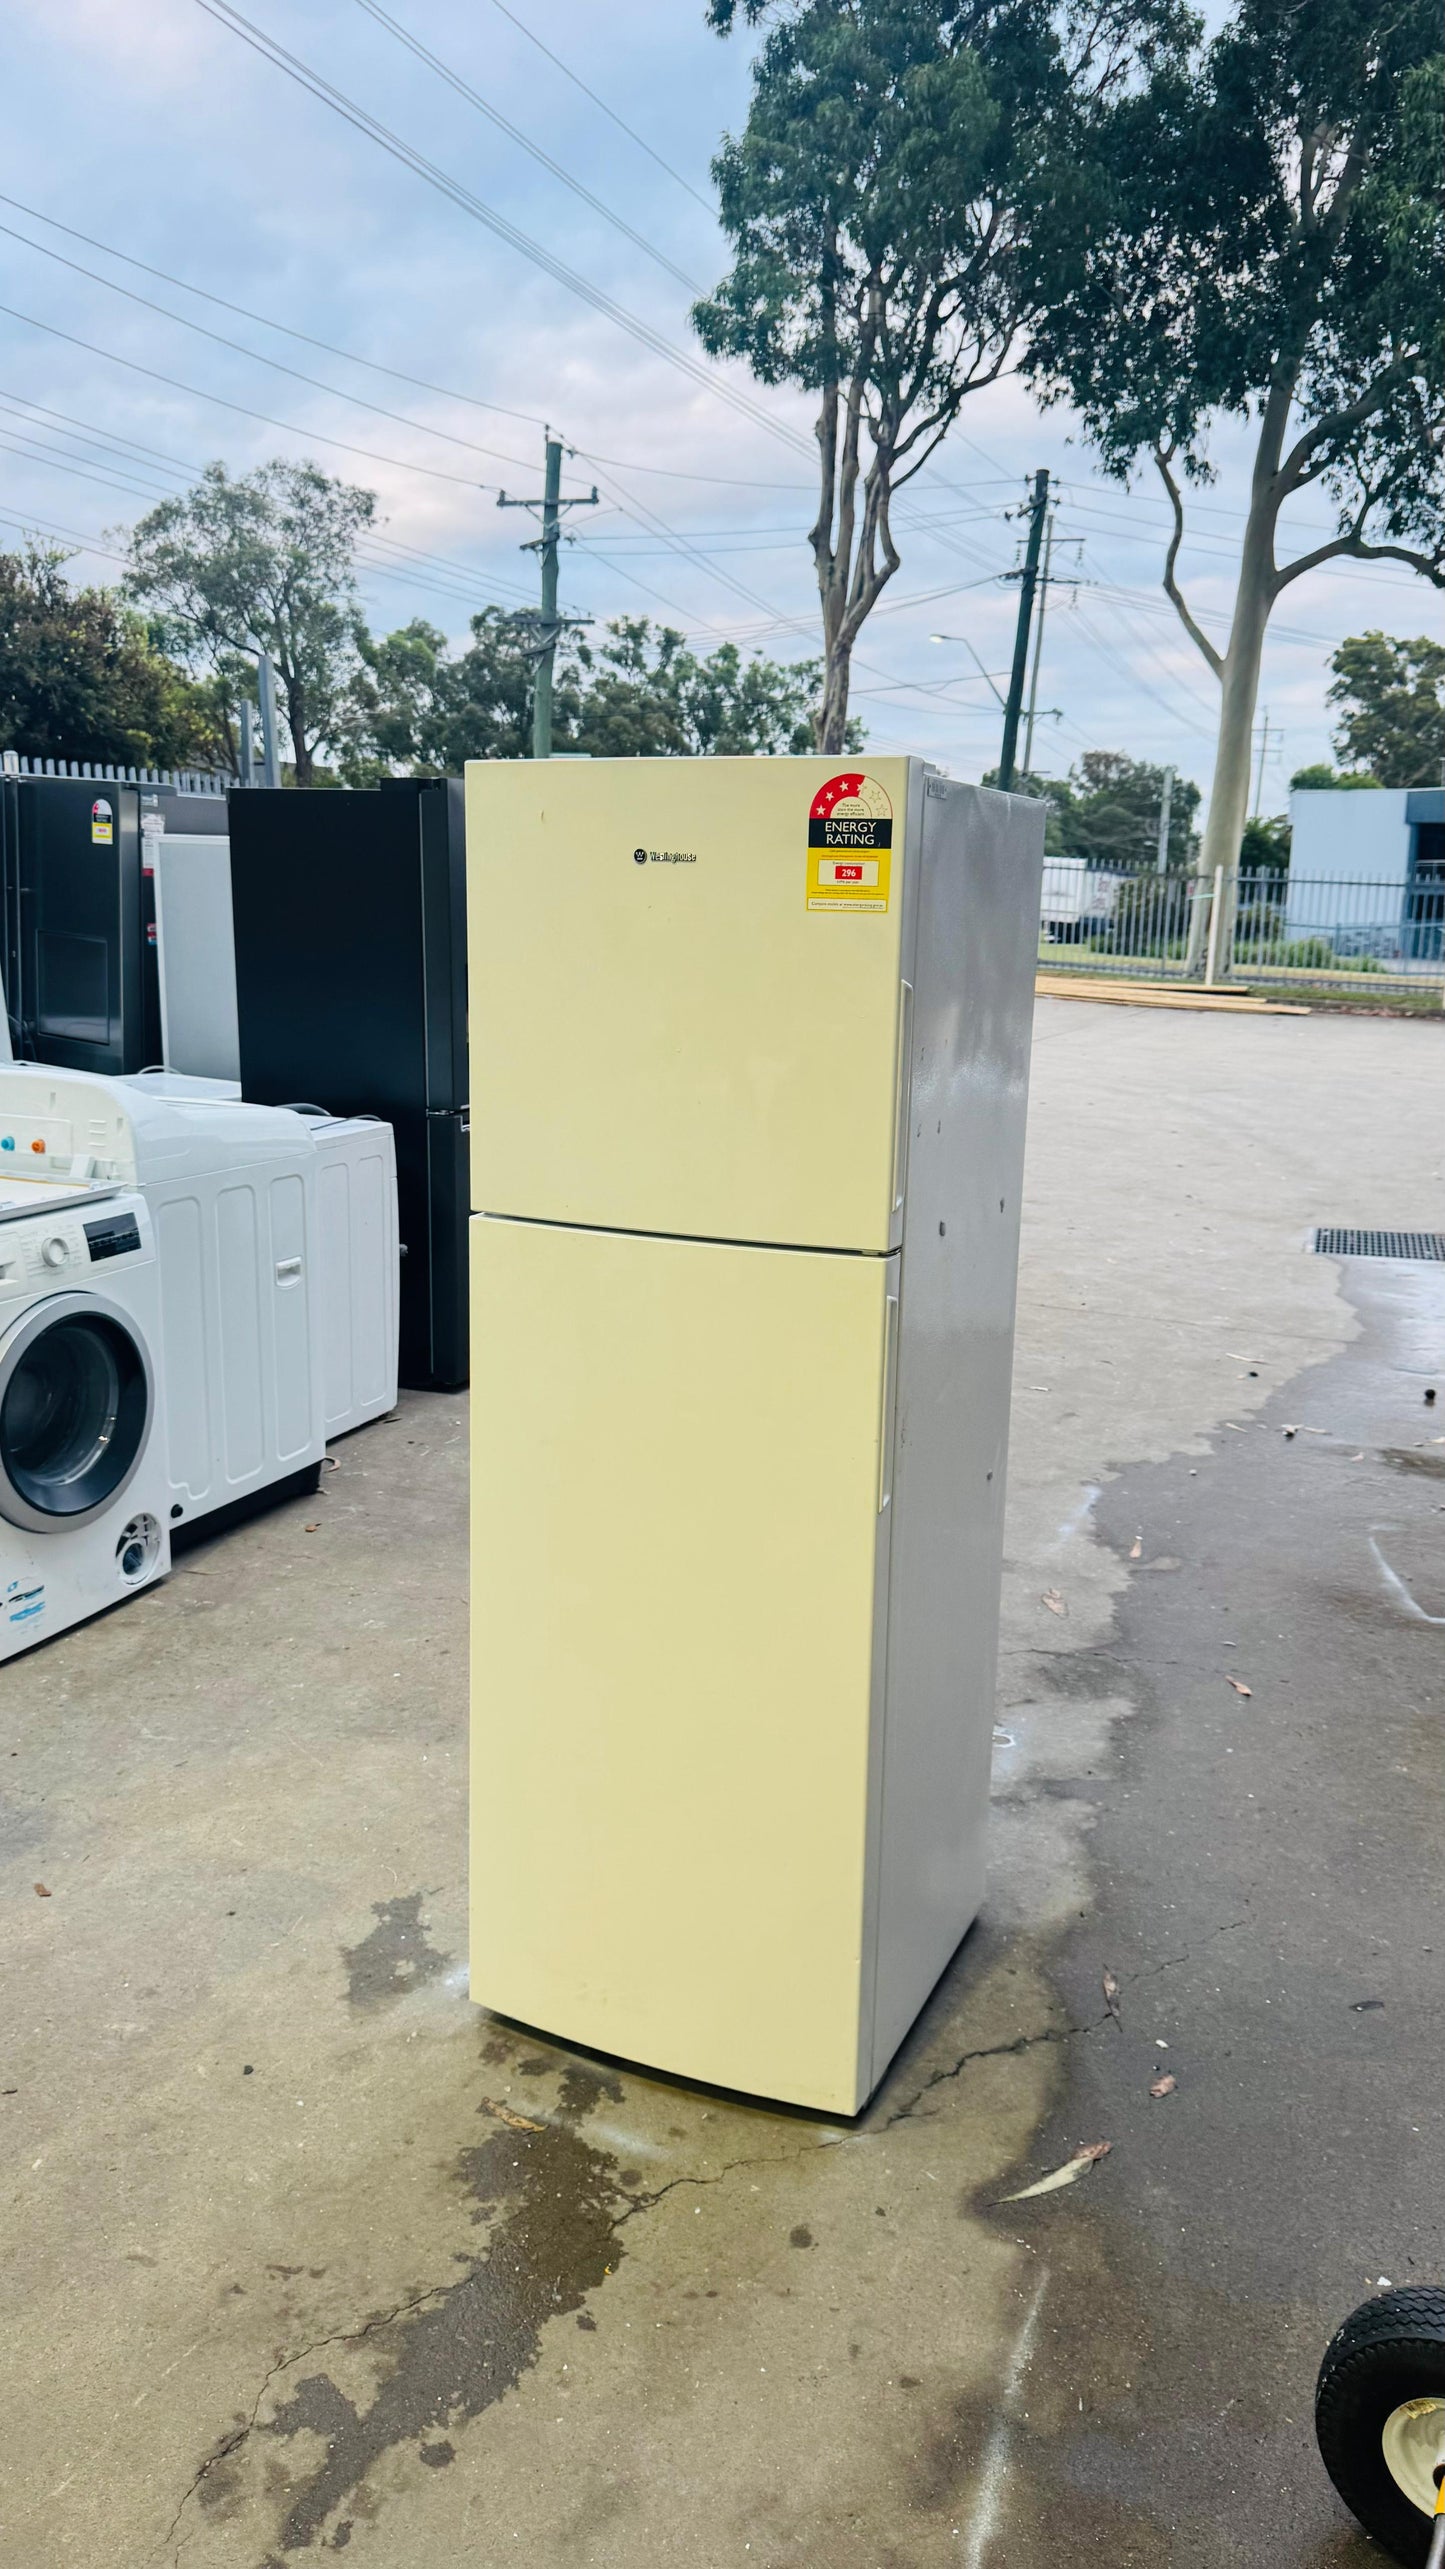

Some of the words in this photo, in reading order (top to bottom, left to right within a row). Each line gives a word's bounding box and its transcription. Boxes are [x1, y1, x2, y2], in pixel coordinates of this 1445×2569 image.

[825, 821, 877, 833] ENERGY
[826, 834, 874, 845] RATING
[841, 869, 857, 877] 296
